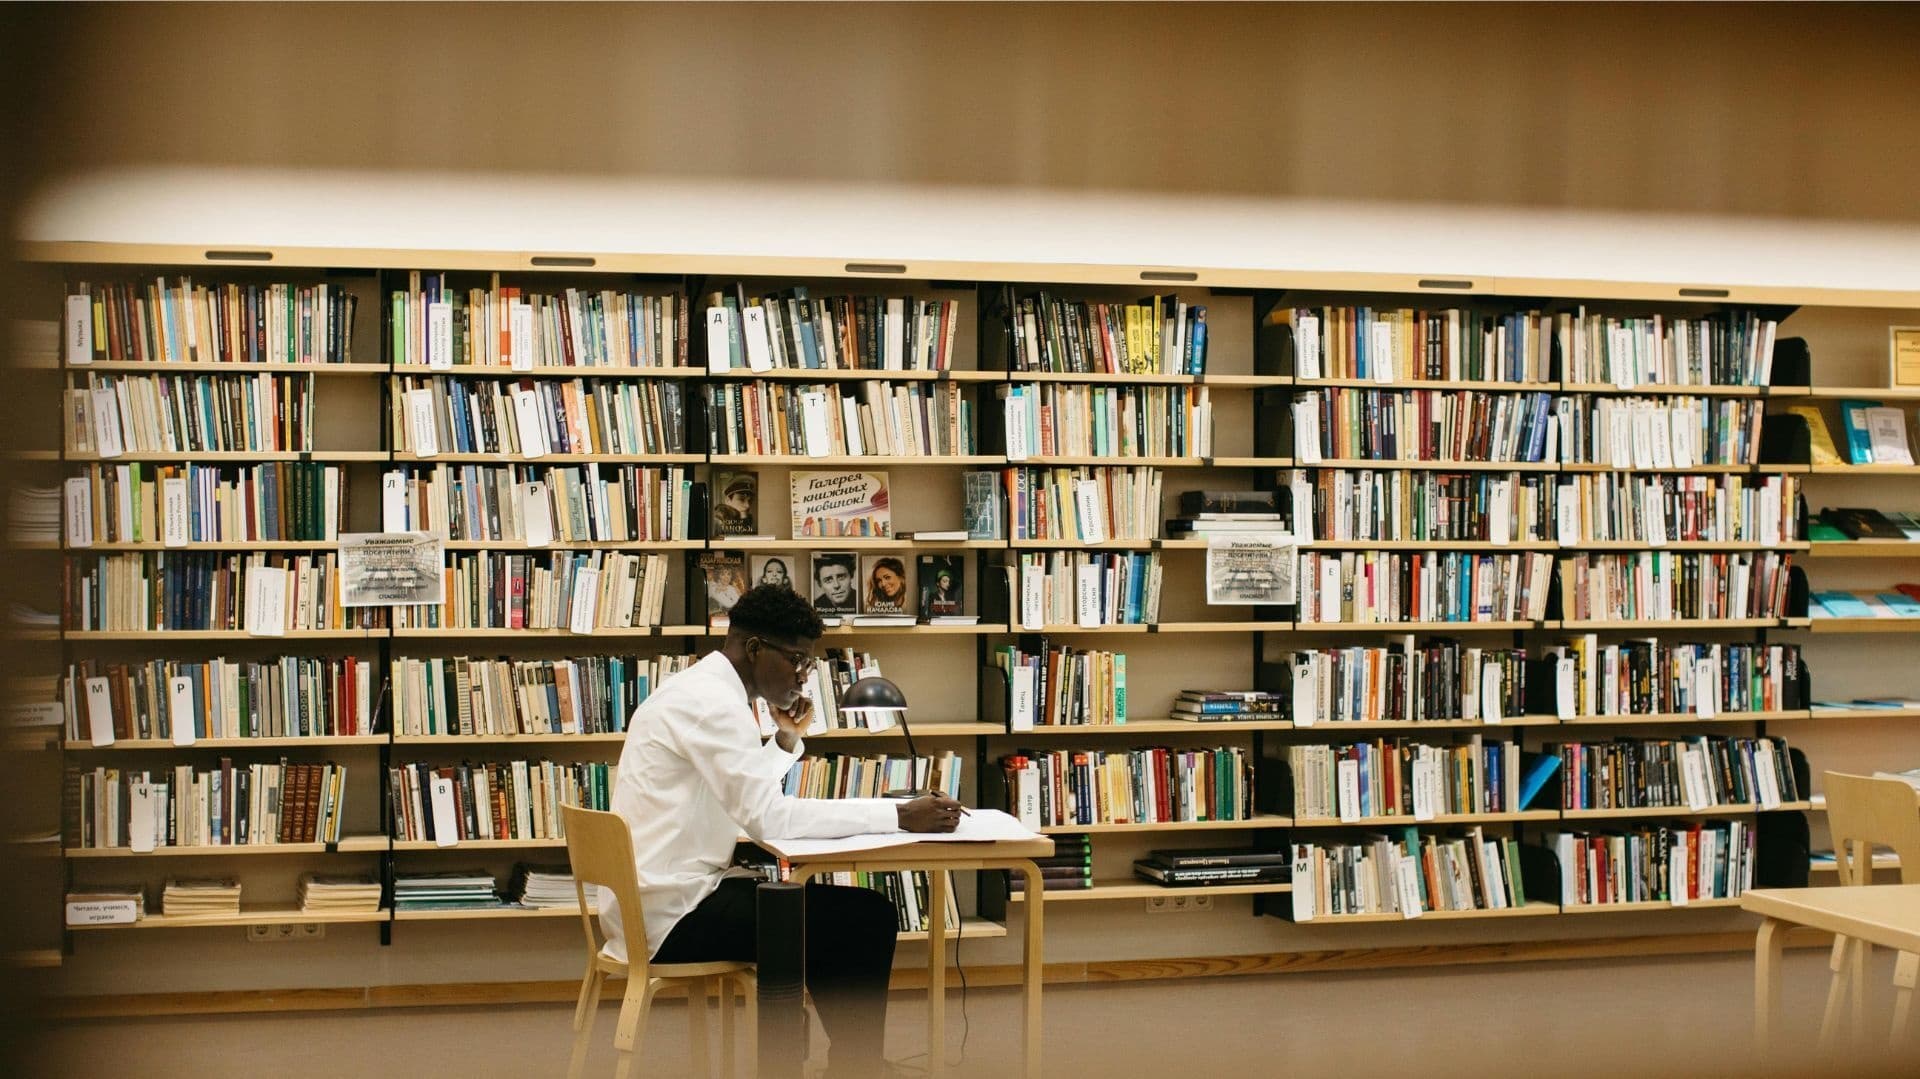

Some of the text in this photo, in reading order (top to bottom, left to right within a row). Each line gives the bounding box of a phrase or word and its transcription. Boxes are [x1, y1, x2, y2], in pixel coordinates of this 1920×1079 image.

[713, 313, 723, 324] Д
[750, 313, 757, 322] К
[522, 397, 529, 408] Г
[810, 398, 817, 407] Т
[386, 480, 395, 488] Л
[809, 473, 863, 490] Галерея
[530, 486, 538, 496] Р
[803, 483, 868, 503] книжных
[1497, 488, 1503, 498] Г
[806, 493, 866, 514] новинок!
[1301, 669, 1309, 680] Р
[91, 684, 103, 694] М
[177, 683, 185, 694] Р
[139, 788, 148, 799] Ч
[438, 785, 446, 794] В
[1296, 863, 1307, 873] М
